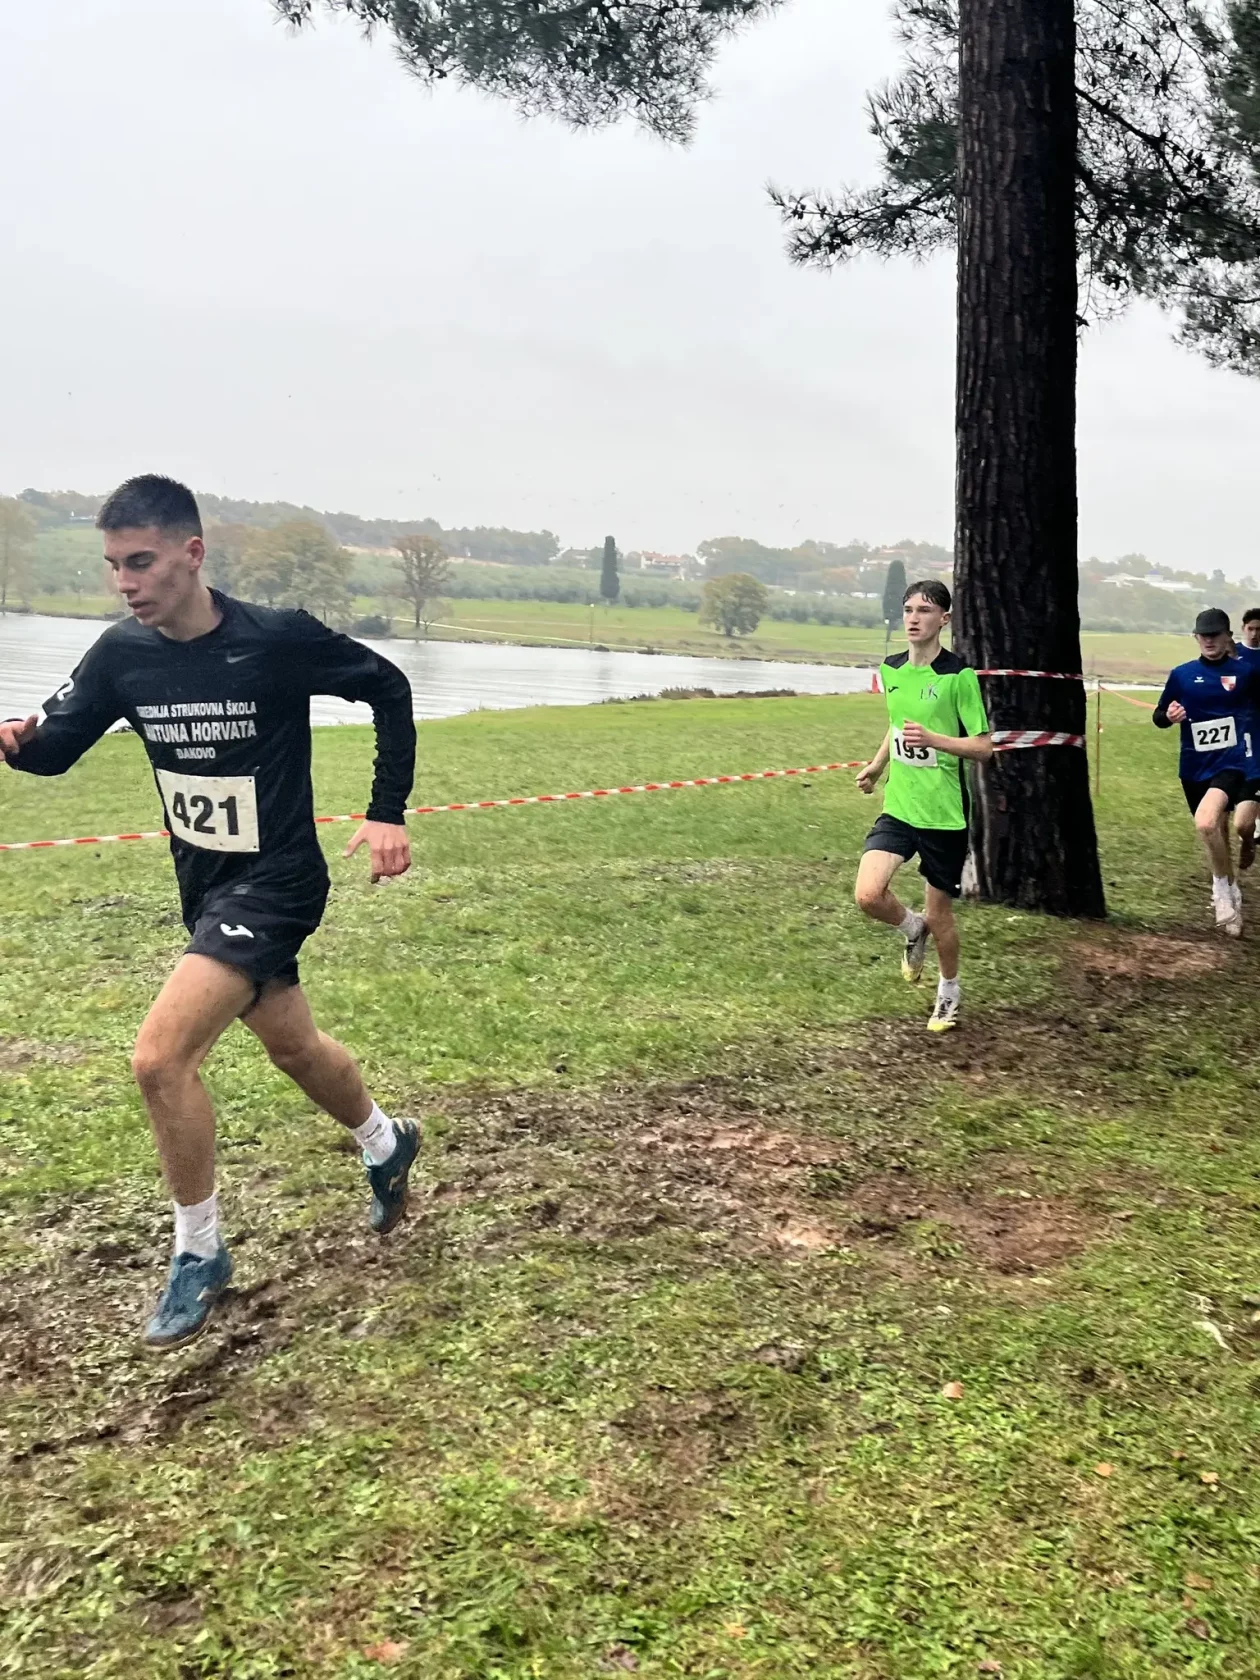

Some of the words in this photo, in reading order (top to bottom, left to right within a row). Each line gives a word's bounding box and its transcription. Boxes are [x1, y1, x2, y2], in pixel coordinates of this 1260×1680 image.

[171, 702, 224, 717] STRUKOVNA
[226, 700, 257, 715] ŠKOLA
[191, 720, 257, 741] HORVATA
[1197, 725, 1230, 745] 227
[173, 792, 240, 836] 421
